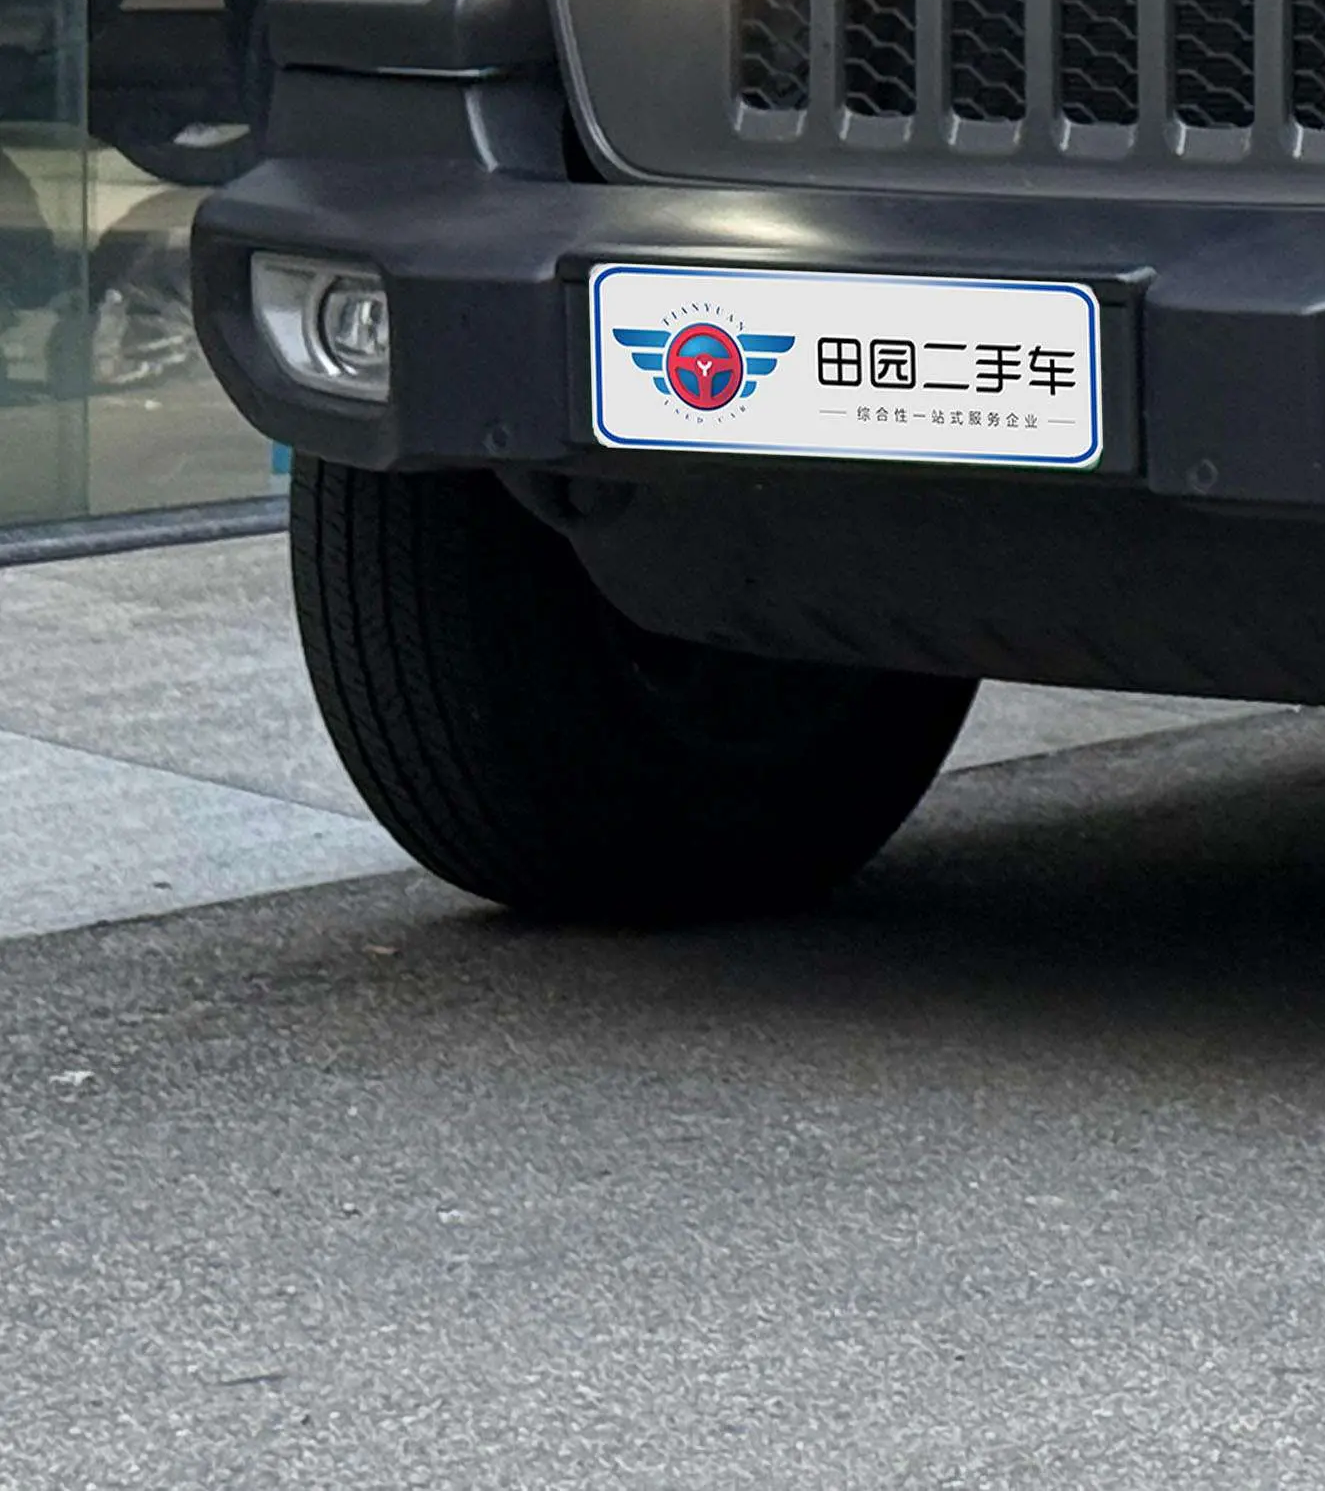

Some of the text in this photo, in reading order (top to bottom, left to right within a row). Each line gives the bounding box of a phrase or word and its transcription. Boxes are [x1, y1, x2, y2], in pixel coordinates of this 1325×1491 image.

[816, 336, 1077, 396] 田园二手车
[856, 405, 1038, 429] 综合性一站式服务企业
